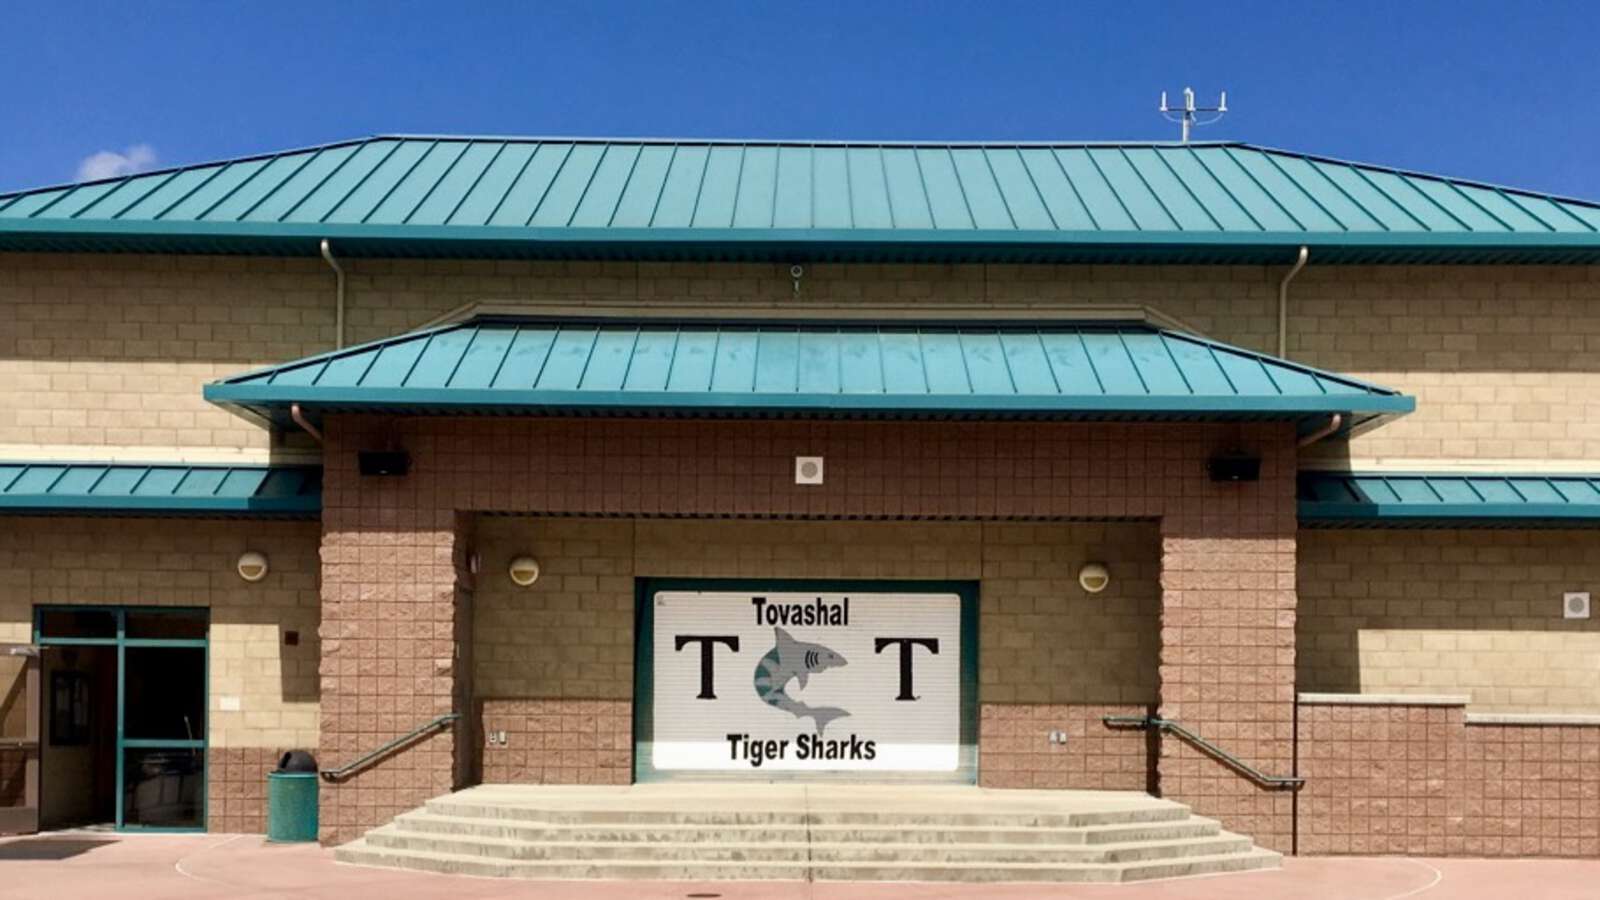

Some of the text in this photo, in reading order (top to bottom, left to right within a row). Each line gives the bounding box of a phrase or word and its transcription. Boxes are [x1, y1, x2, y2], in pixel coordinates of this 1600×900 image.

[752, 596, 849, 626] Tovashal
[675, 634, 739, 700] T
[874, 637, 939, 701] T
[727, 733, 876, 767] Tiger Sharks
